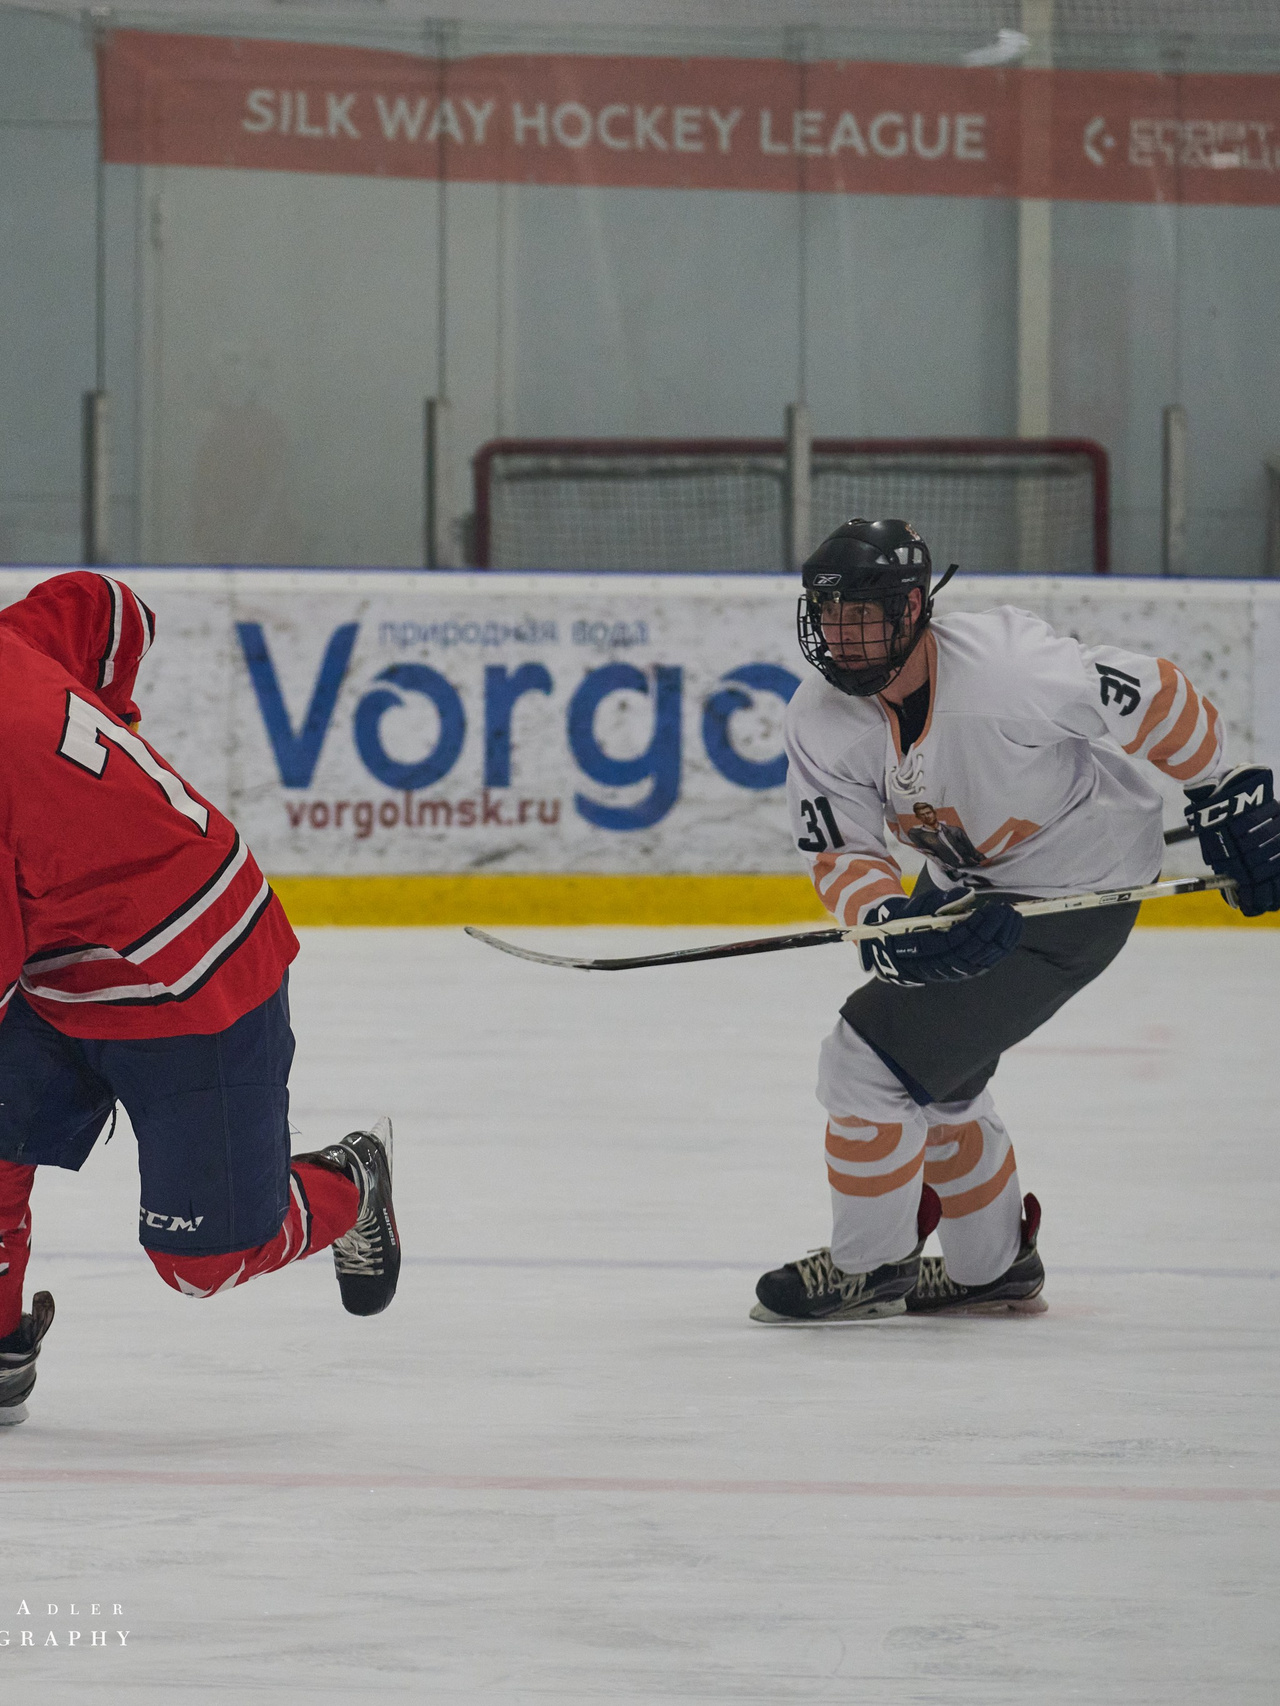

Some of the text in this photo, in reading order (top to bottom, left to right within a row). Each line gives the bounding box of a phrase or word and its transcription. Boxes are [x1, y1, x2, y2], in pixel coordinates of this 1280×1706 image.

[243, 89, 987, 162] SILK WAY HOCKEY LEAGUE
[378, 618, 650, 649] природная вода
[1095, 662, 1141, 718] 31
[235, 621, 803, 831] Vorgo
[285, 792, 561, 839] vorgolmsk.ru
[797, 795, 846, 854] 31
[382, 1207, 397, 1246] BAUER
